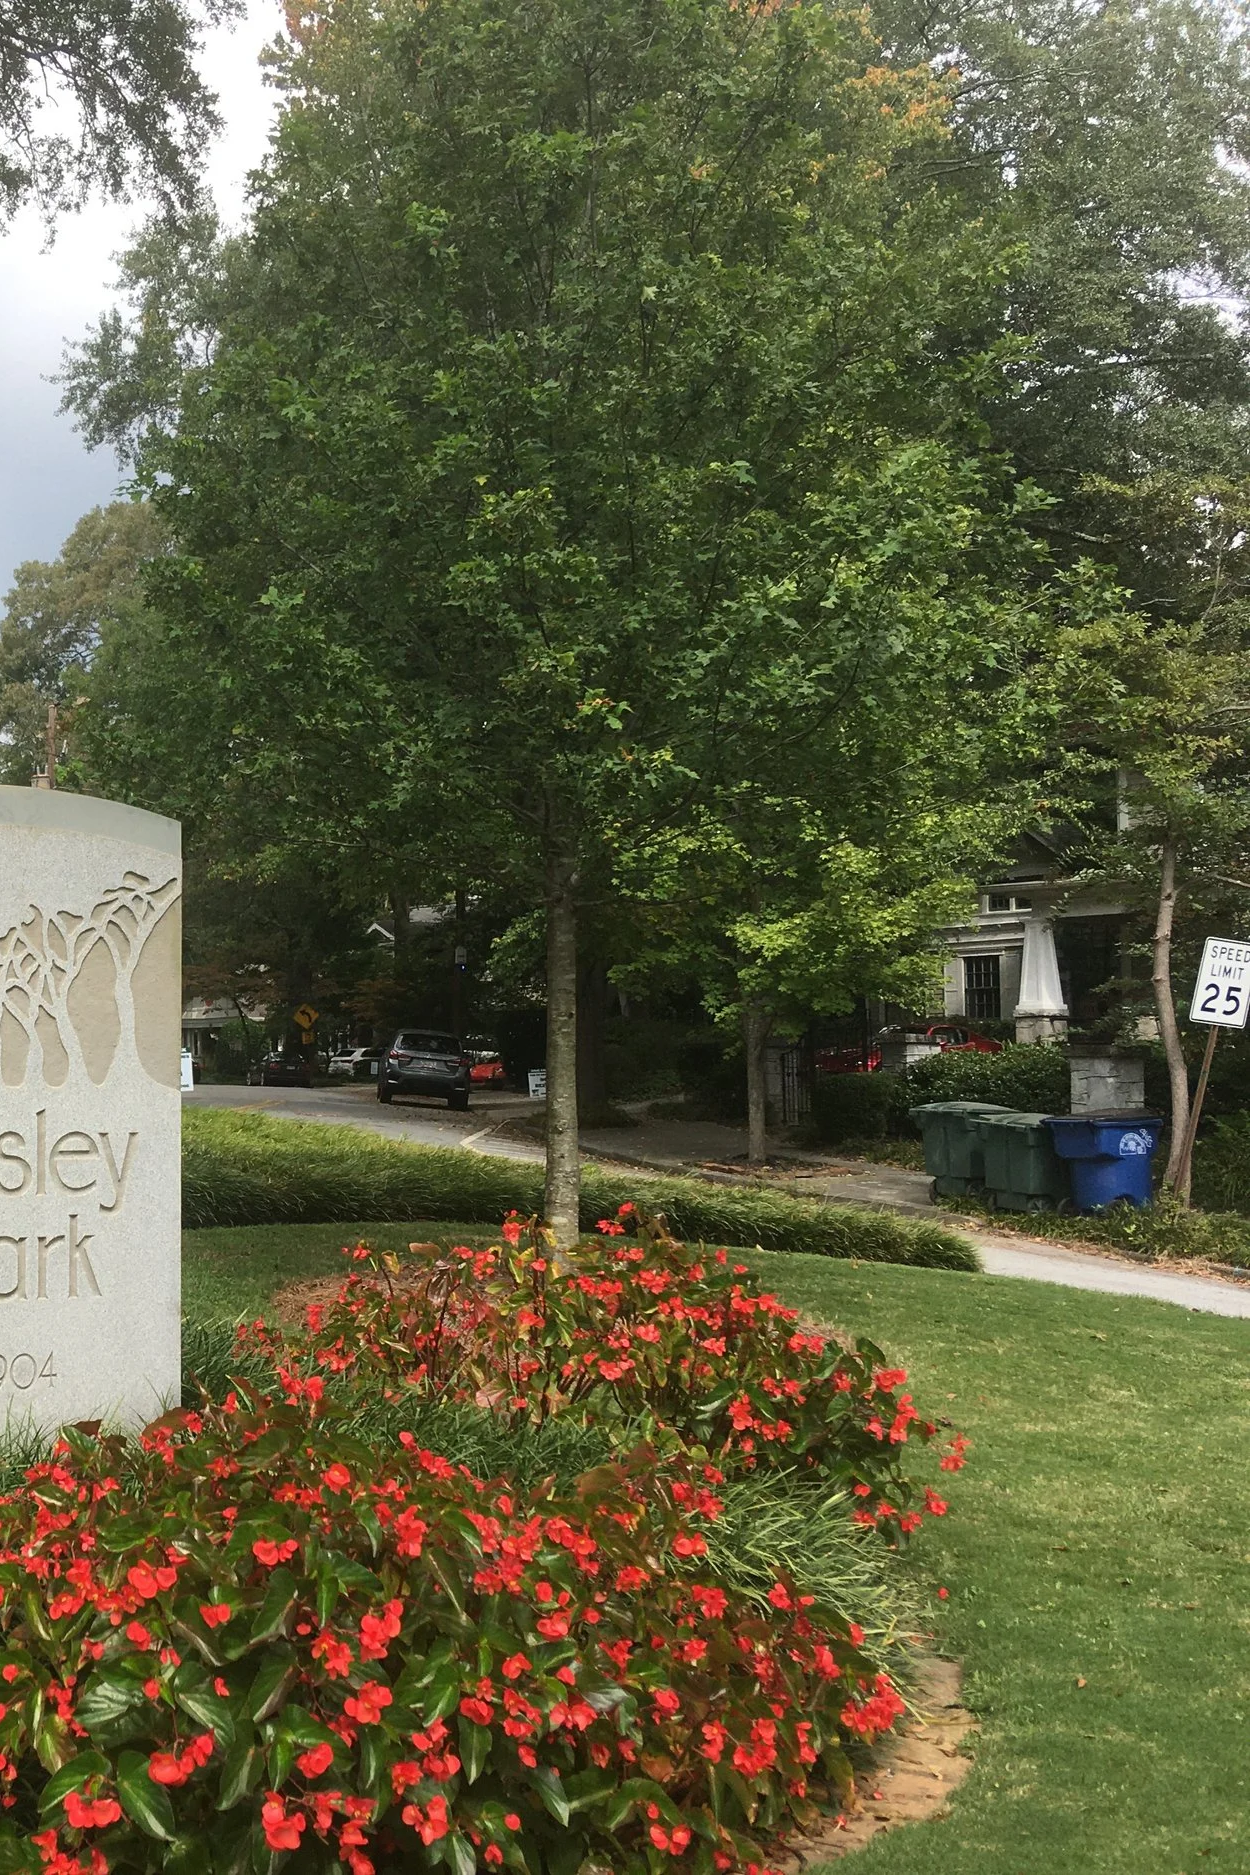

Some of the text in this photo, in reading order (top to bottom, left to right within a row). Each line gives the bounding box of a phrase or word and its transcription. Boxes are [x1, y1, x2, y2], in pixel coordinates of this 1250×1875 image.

[1210, 945, 1250, 963] SPEED
[1211, 964, 1244, 980] LIMIT
[1200, 983, 1242, 1015] 25
